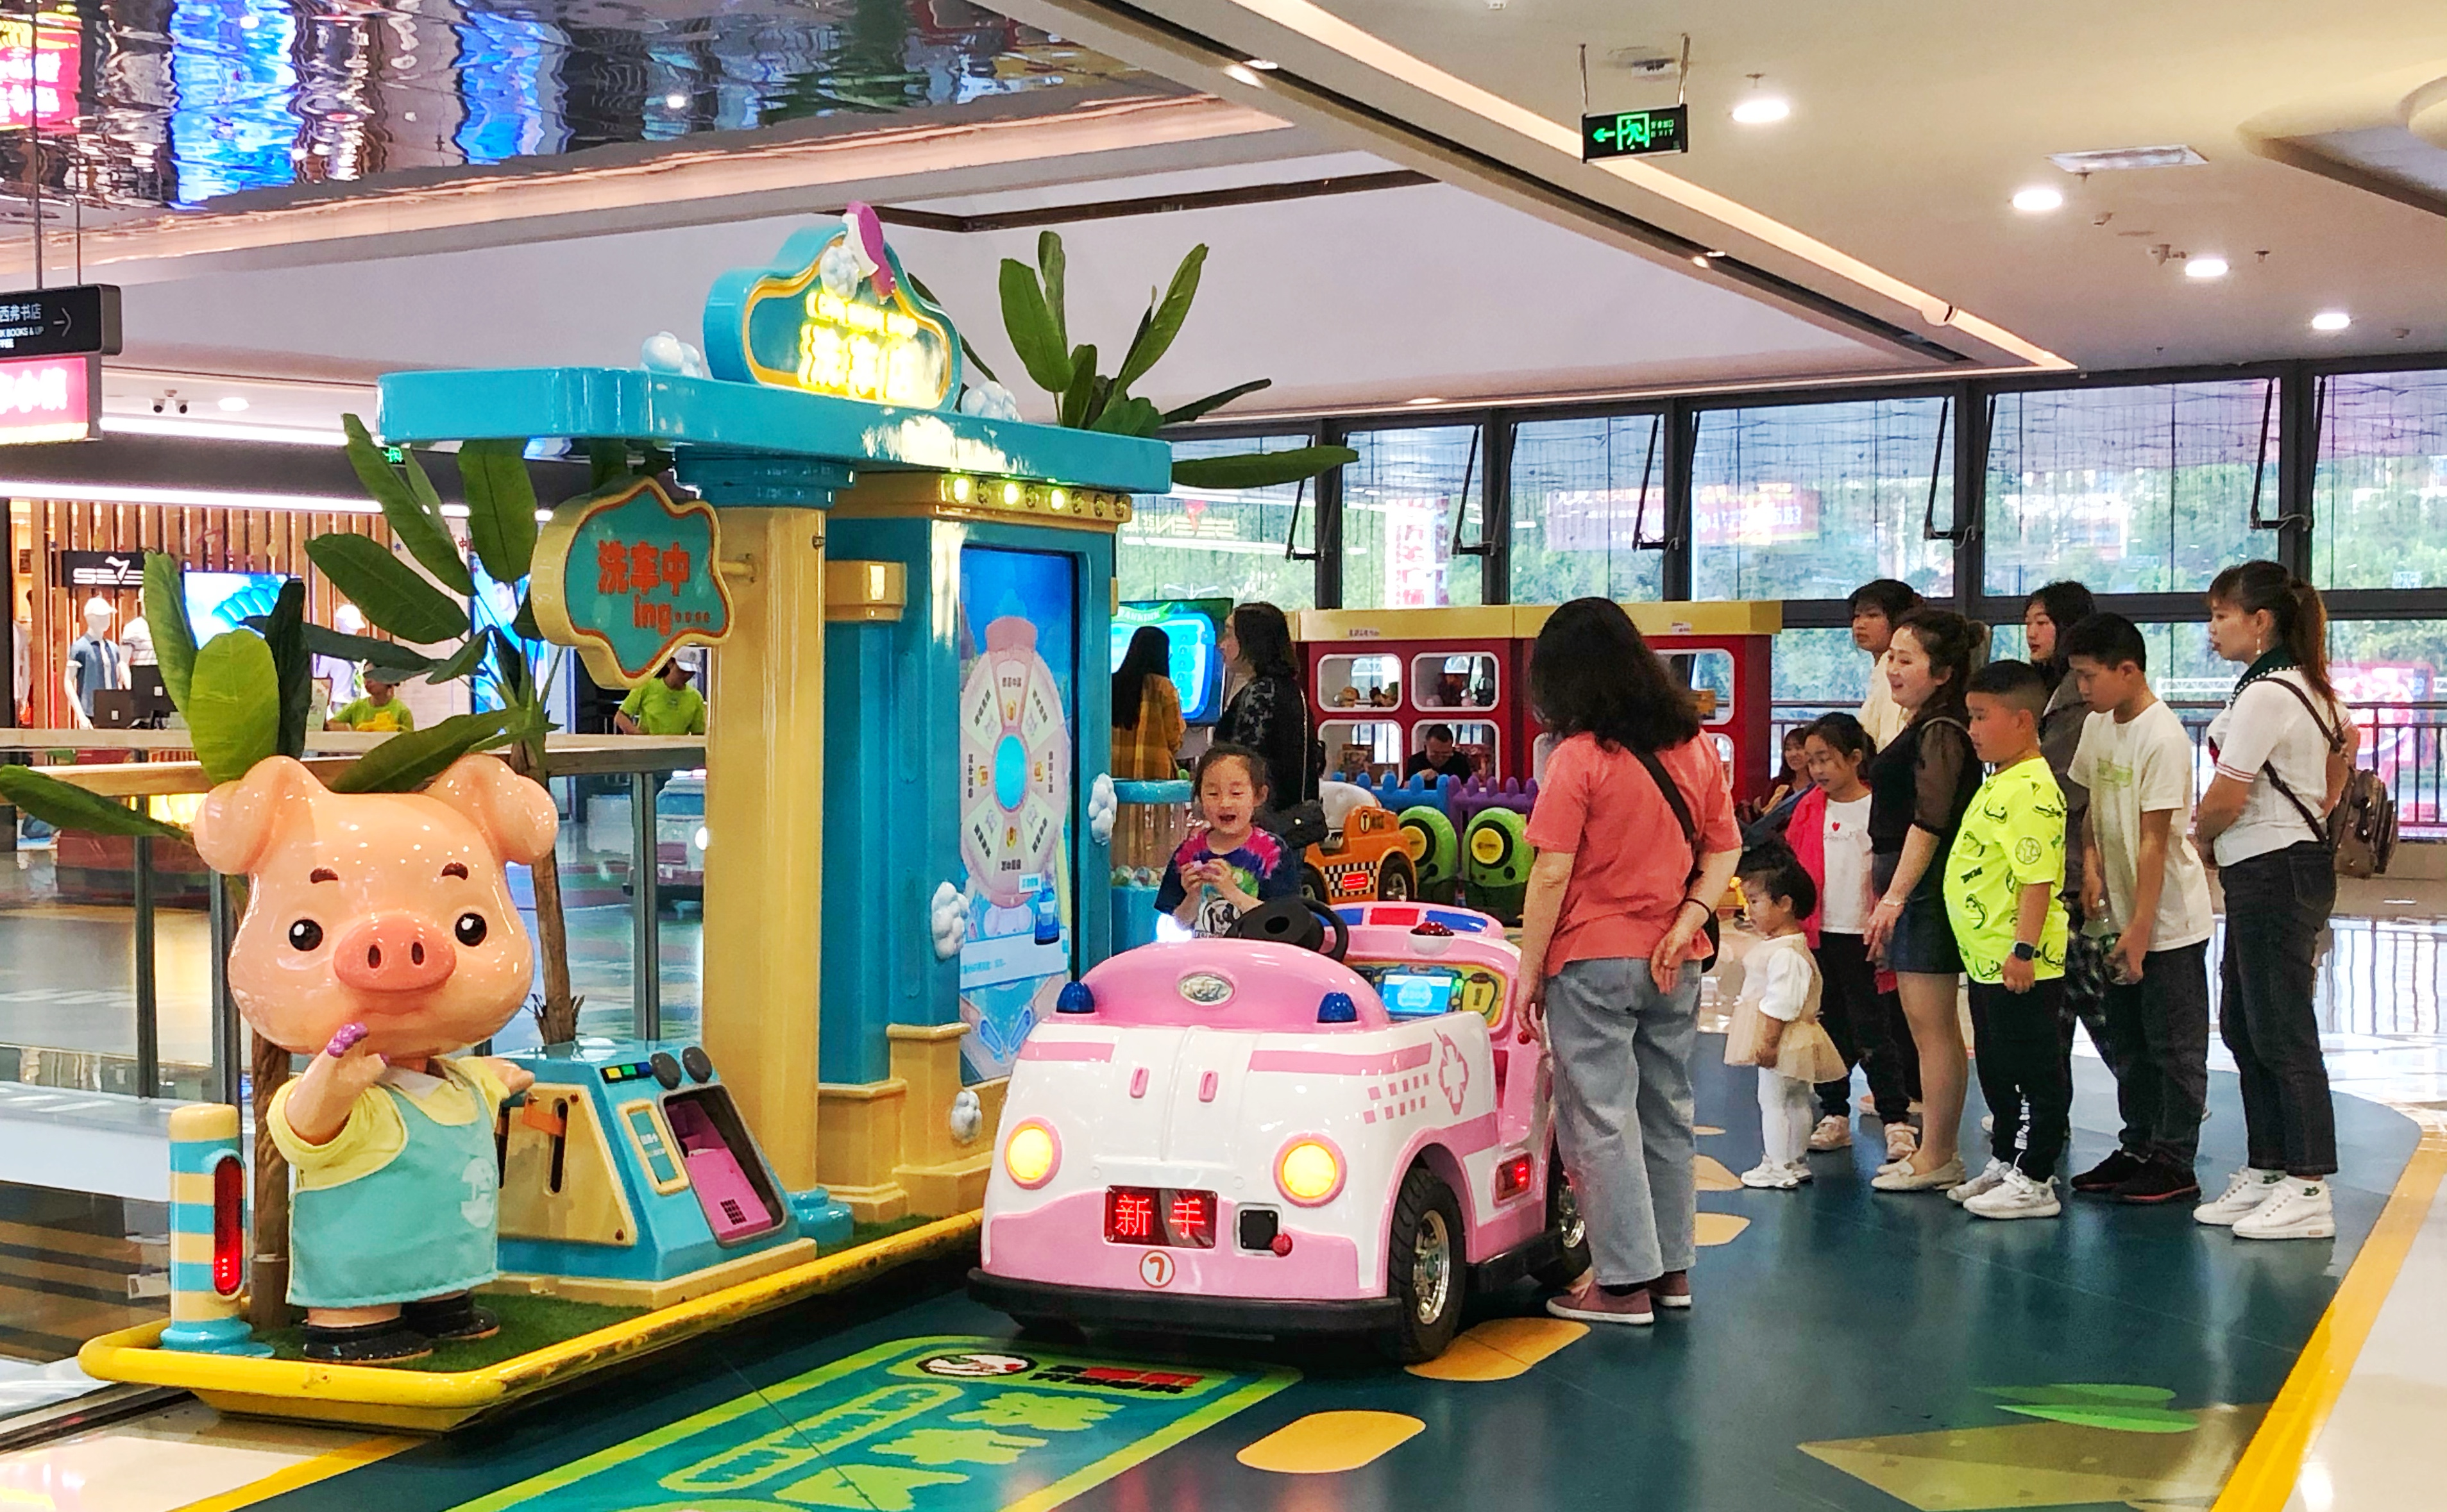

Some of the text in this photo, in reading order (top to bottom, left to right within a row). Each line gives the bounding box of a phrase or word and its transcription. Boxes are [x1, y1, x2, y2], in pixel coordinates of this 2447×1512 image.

[1650, 128, 1674, 138] EXIT
[6, 327, 28, 337] BOOKS
[35, 326, 44, 335] UP
[597, 539, 691, 597] 洗车中
[1148, 1256, 1165, 1282] 7
